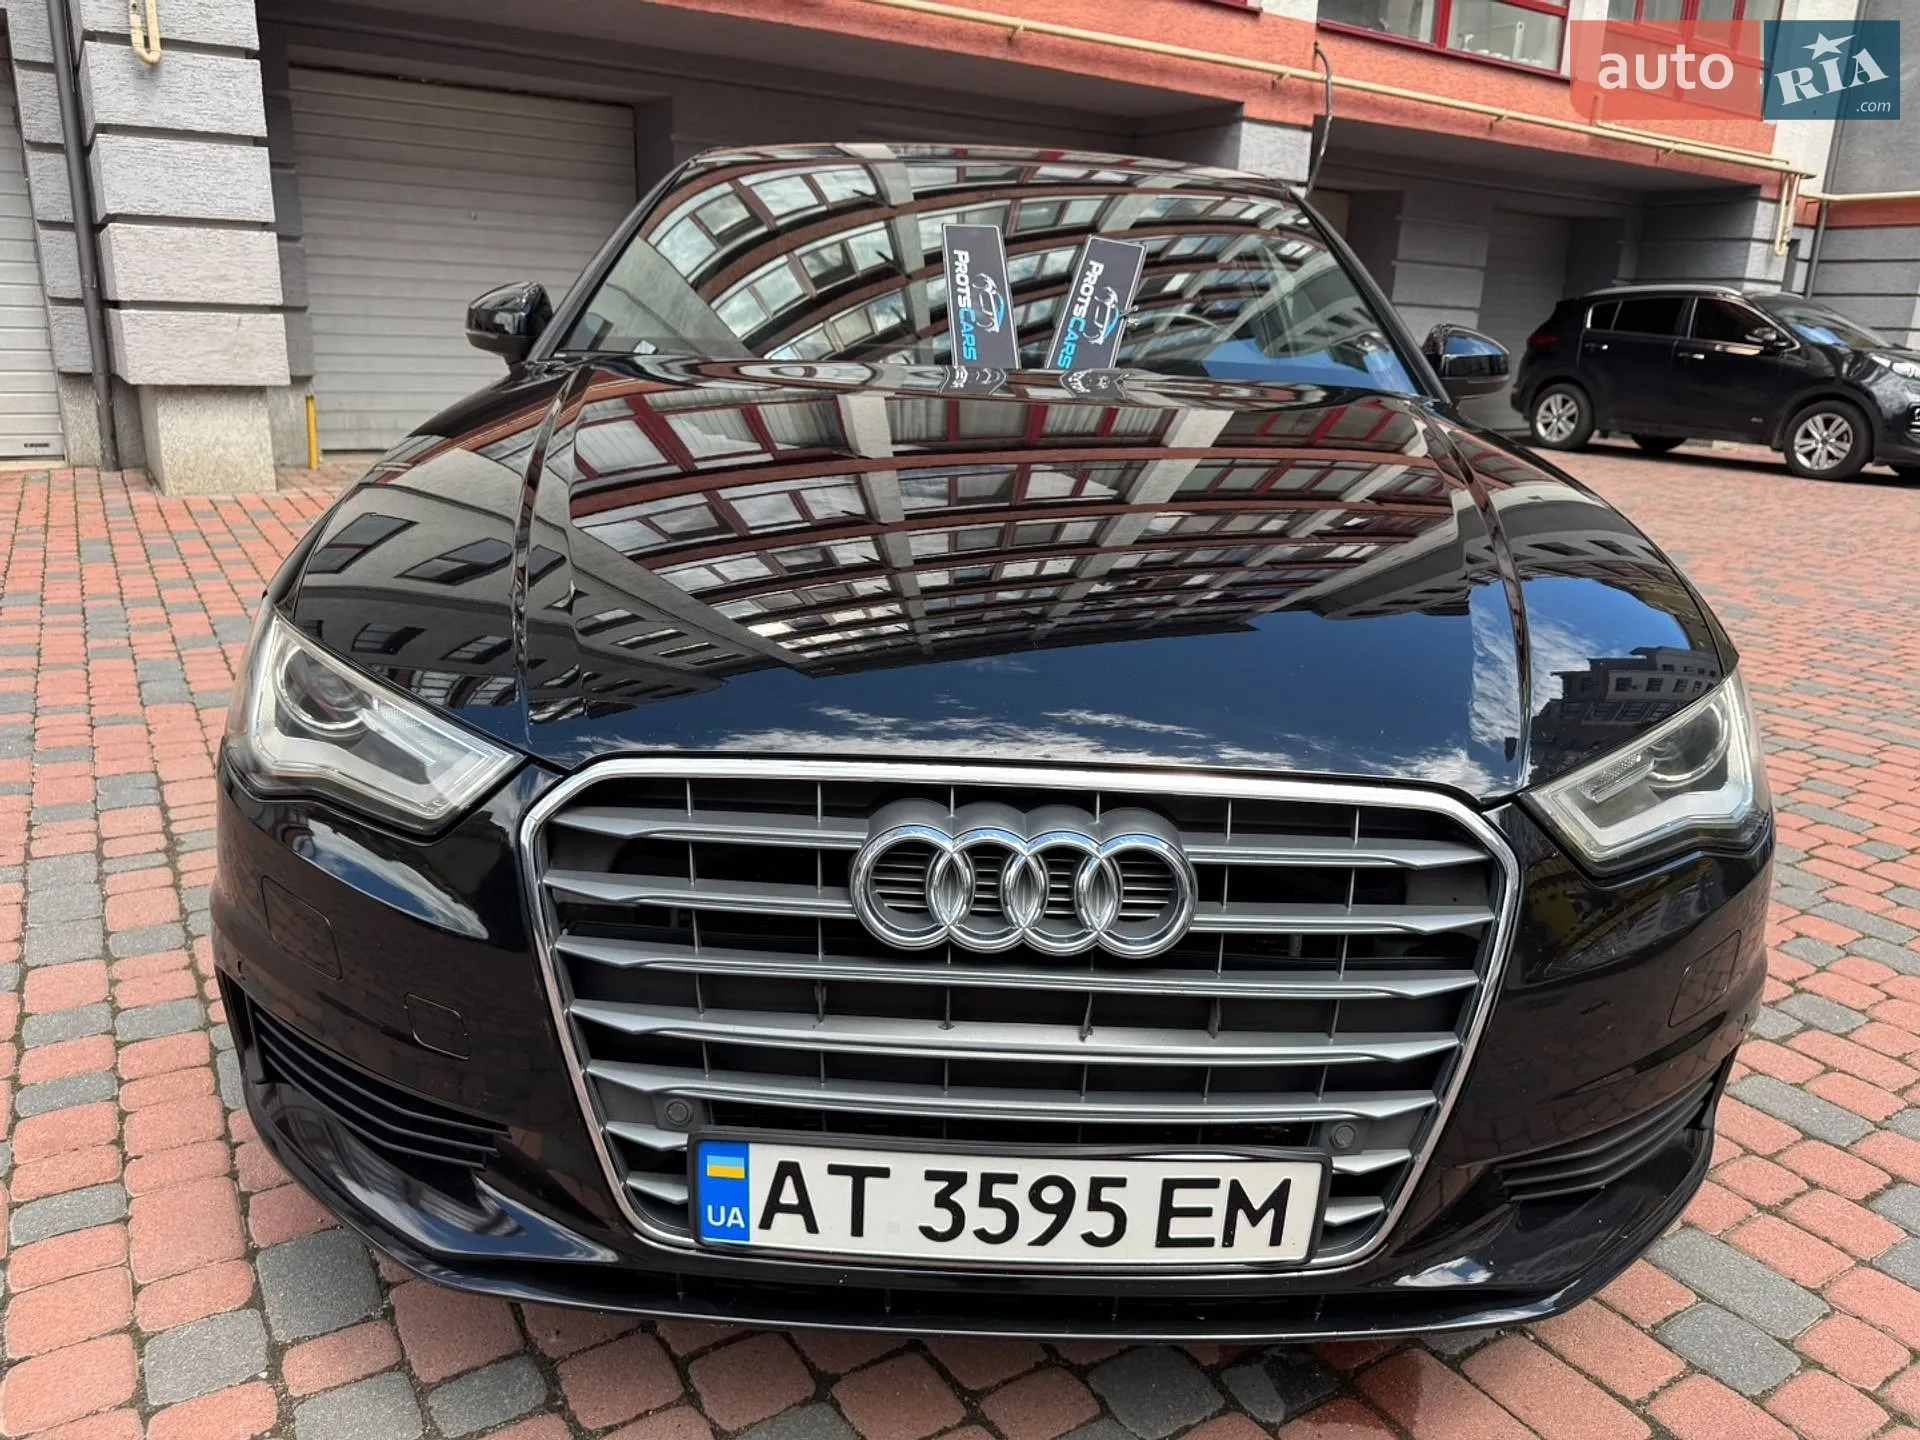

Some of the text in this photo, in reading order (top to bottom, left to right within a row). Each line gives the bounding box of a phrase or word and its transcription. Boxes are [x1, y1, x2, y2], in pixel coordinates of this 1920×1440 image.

[706, 1203, 746, 1229] UA
[758, 1160, 1293, 1248] AT 3595 EM
